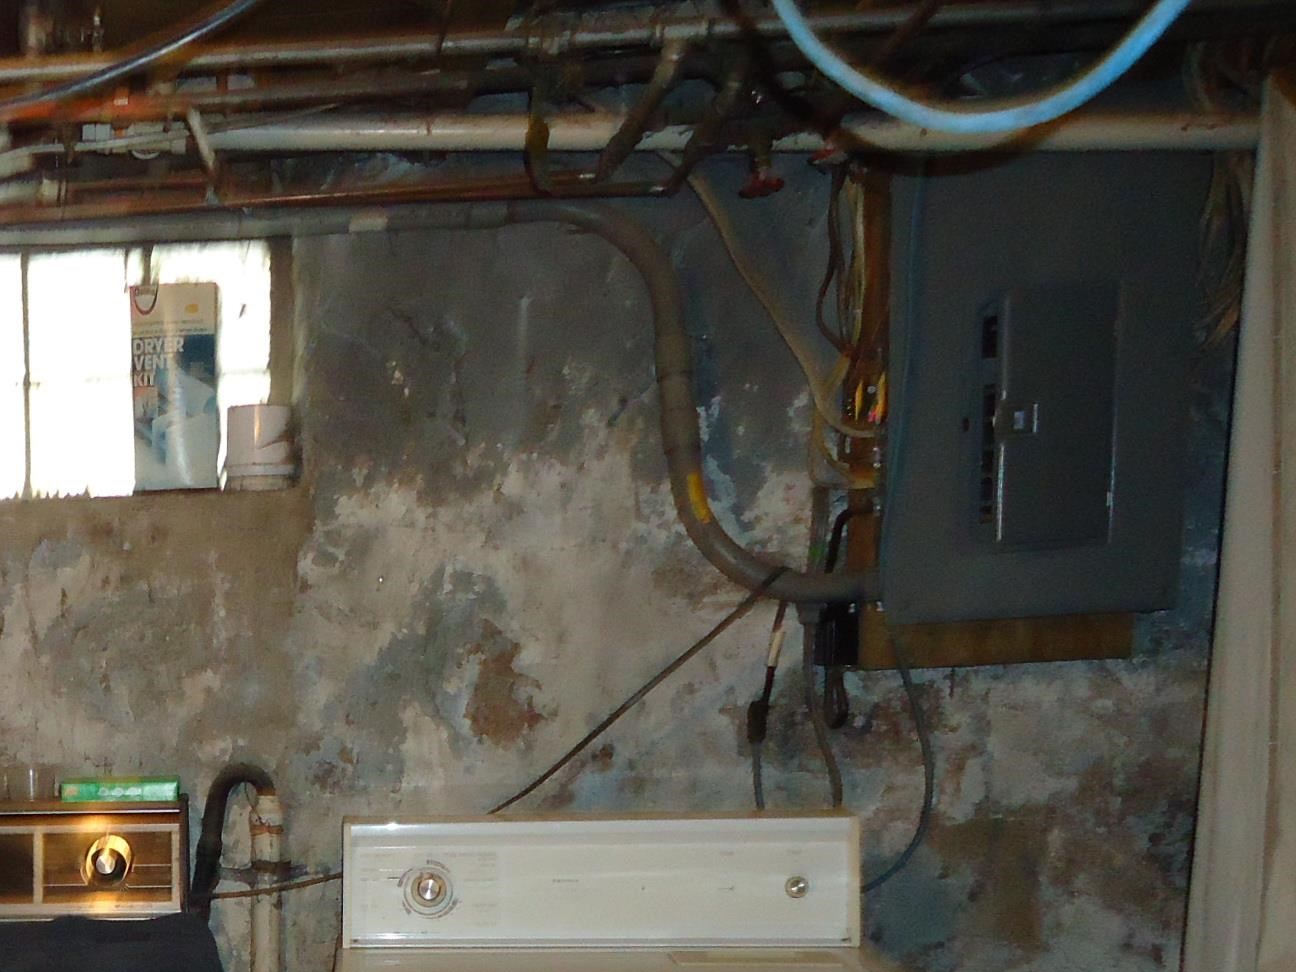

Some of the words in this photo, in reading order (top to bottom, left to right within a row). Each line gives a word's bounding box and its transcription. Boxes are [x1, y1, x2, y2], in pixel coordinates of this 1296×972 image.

[133, 336, 184, 355] DRYER
[134, 353, 170, 371] VENT
[134, 371, 156, 387] KIT
